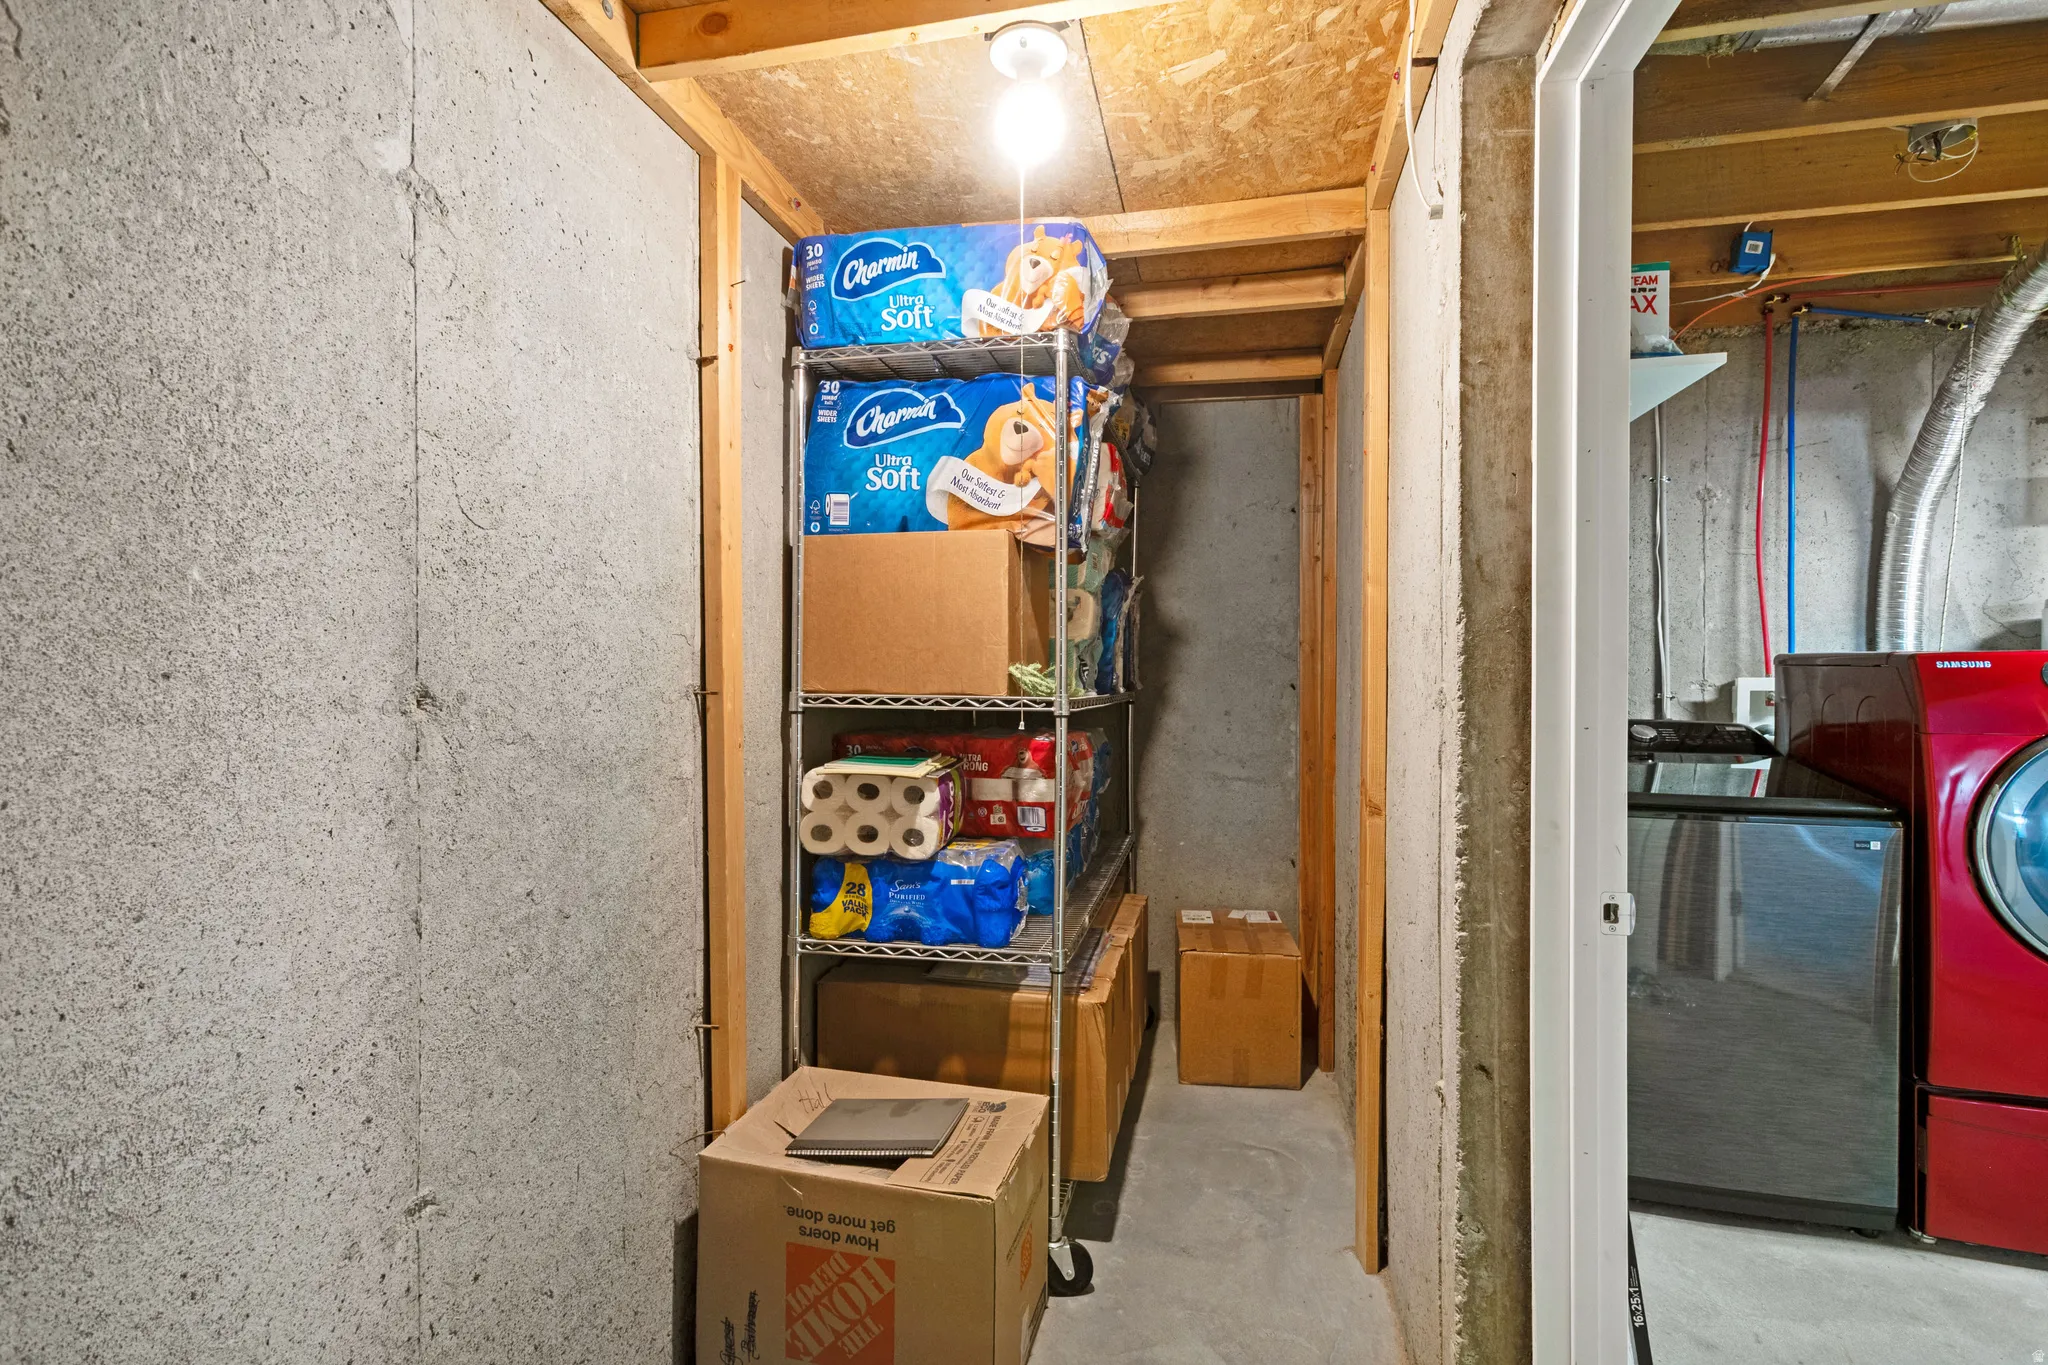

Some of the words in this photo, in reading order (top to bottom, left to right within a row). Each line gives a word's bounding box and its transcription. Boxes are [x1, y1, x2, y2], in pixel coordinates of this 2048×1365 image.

[806, 243, 824, 260] 30
[843, 246, 919, 290] Charmin
[805, 281, 825, 291] SHEETS
[806, 273, 824, 284] WIDER
[1631, 275, 1658, 286] EAM
[889, 294, 924, 308] Ultra
[986, 297, 997, 309] Our
[998, 305, 1018, 320] oftst
[881, 304, 934, 332] Soft
[977, 303, 994, 318] Most
[821, 380, 840, 394] 30
[818, 409, 838, 417] WIDER
[856, 399, 937, 437] Charmin
[875, 453, 912, 468] Ultra
[865, 466, 920, 491] Soft
[961, 468, 975, 481] Our
[974, 476, 998, 497] Softest
[997, 490, 1006, 499] &
[950, 475, 969, 494] Most
[968, 487, 1002, 511] Absorbent
[1936, 660, 1992, 669] SAMSUNG
[846, 744, 862, 757] 30
[963, 761, 989, 772] RONG
[846, 881, 866, 897] 28
[890, 879, 921, 892] Sam's
[888, 891, 926, 901] PURIFIED
[842, 899, 869, 914] VALUE
[978, 1101, 991, 1113] ECO
[783, 1205, 824, 1225] done.
[828, 1213, 866, 1229] more
[870, 1219, 896, 1234] get
[799, 1225, 841, 1245] doers
[845, 1233, 879, 1252] How
[786, 1252, 852, 1317] DEPOT
[785, 1256, 895, 1362] HOME
[1629, 1287, 1645, 1328] 16x25x1
[838, 1316, 884, 1359] THE
